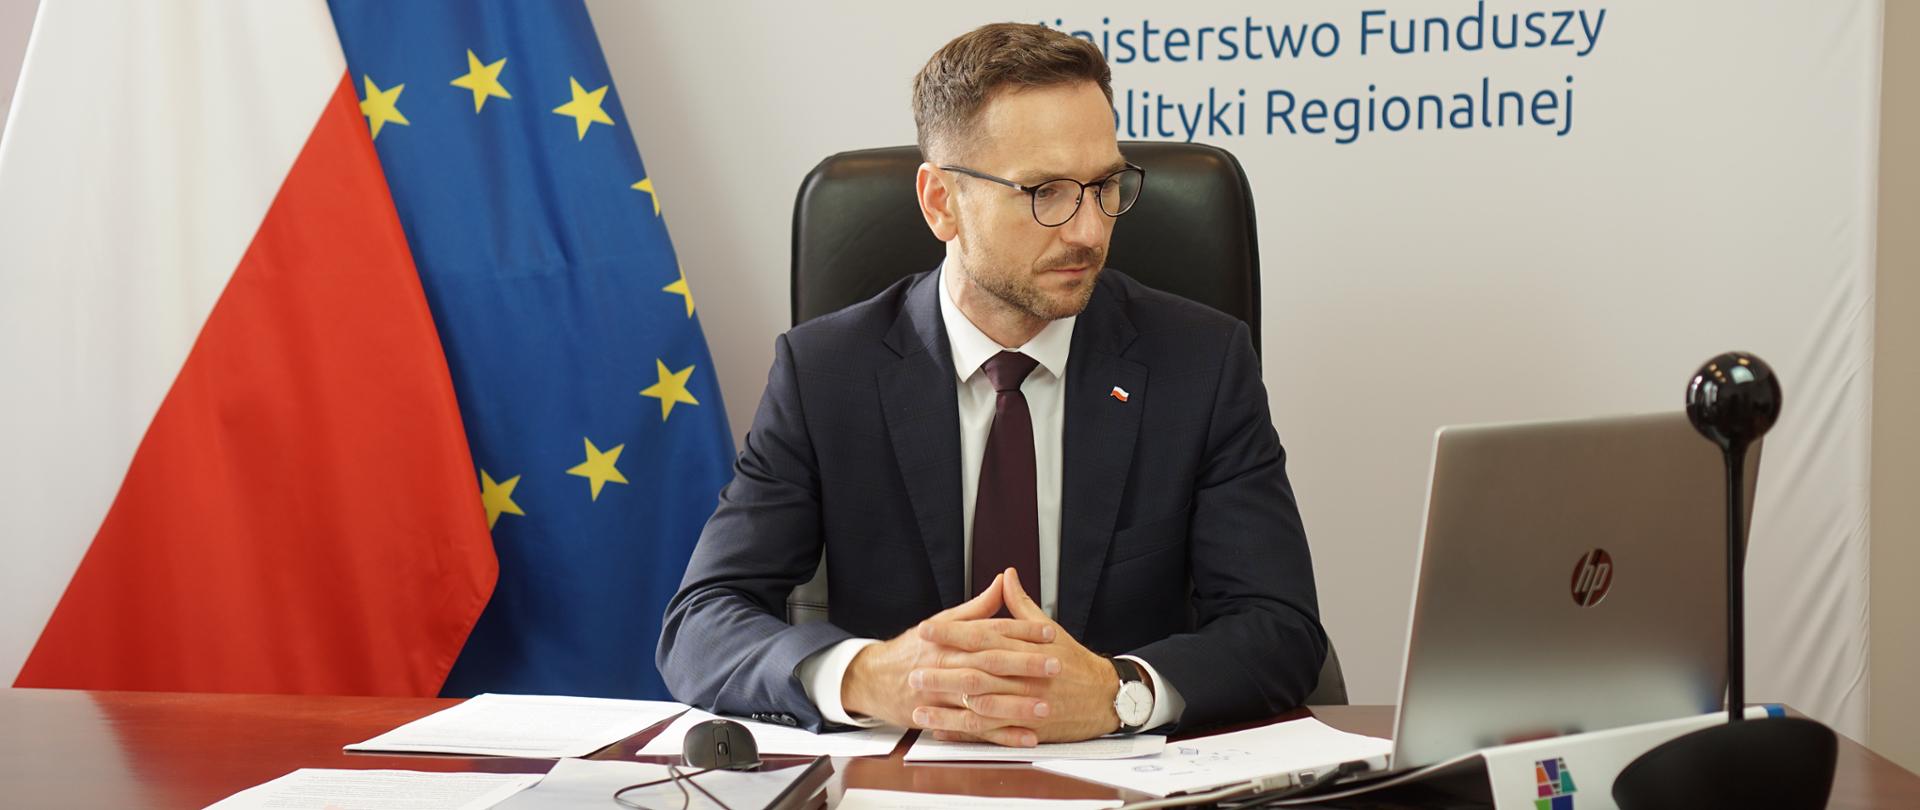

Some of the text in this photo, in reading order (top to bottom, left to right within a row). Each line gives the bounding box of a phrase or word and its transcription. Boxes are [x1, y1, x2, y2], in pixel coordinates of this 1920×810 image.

[1039, 0, 1606, 65] isterstwo Funduszy
[1112, 75, 1574, 145] lityki Regionalnej
[1574, 551, 1610, 607] hp
